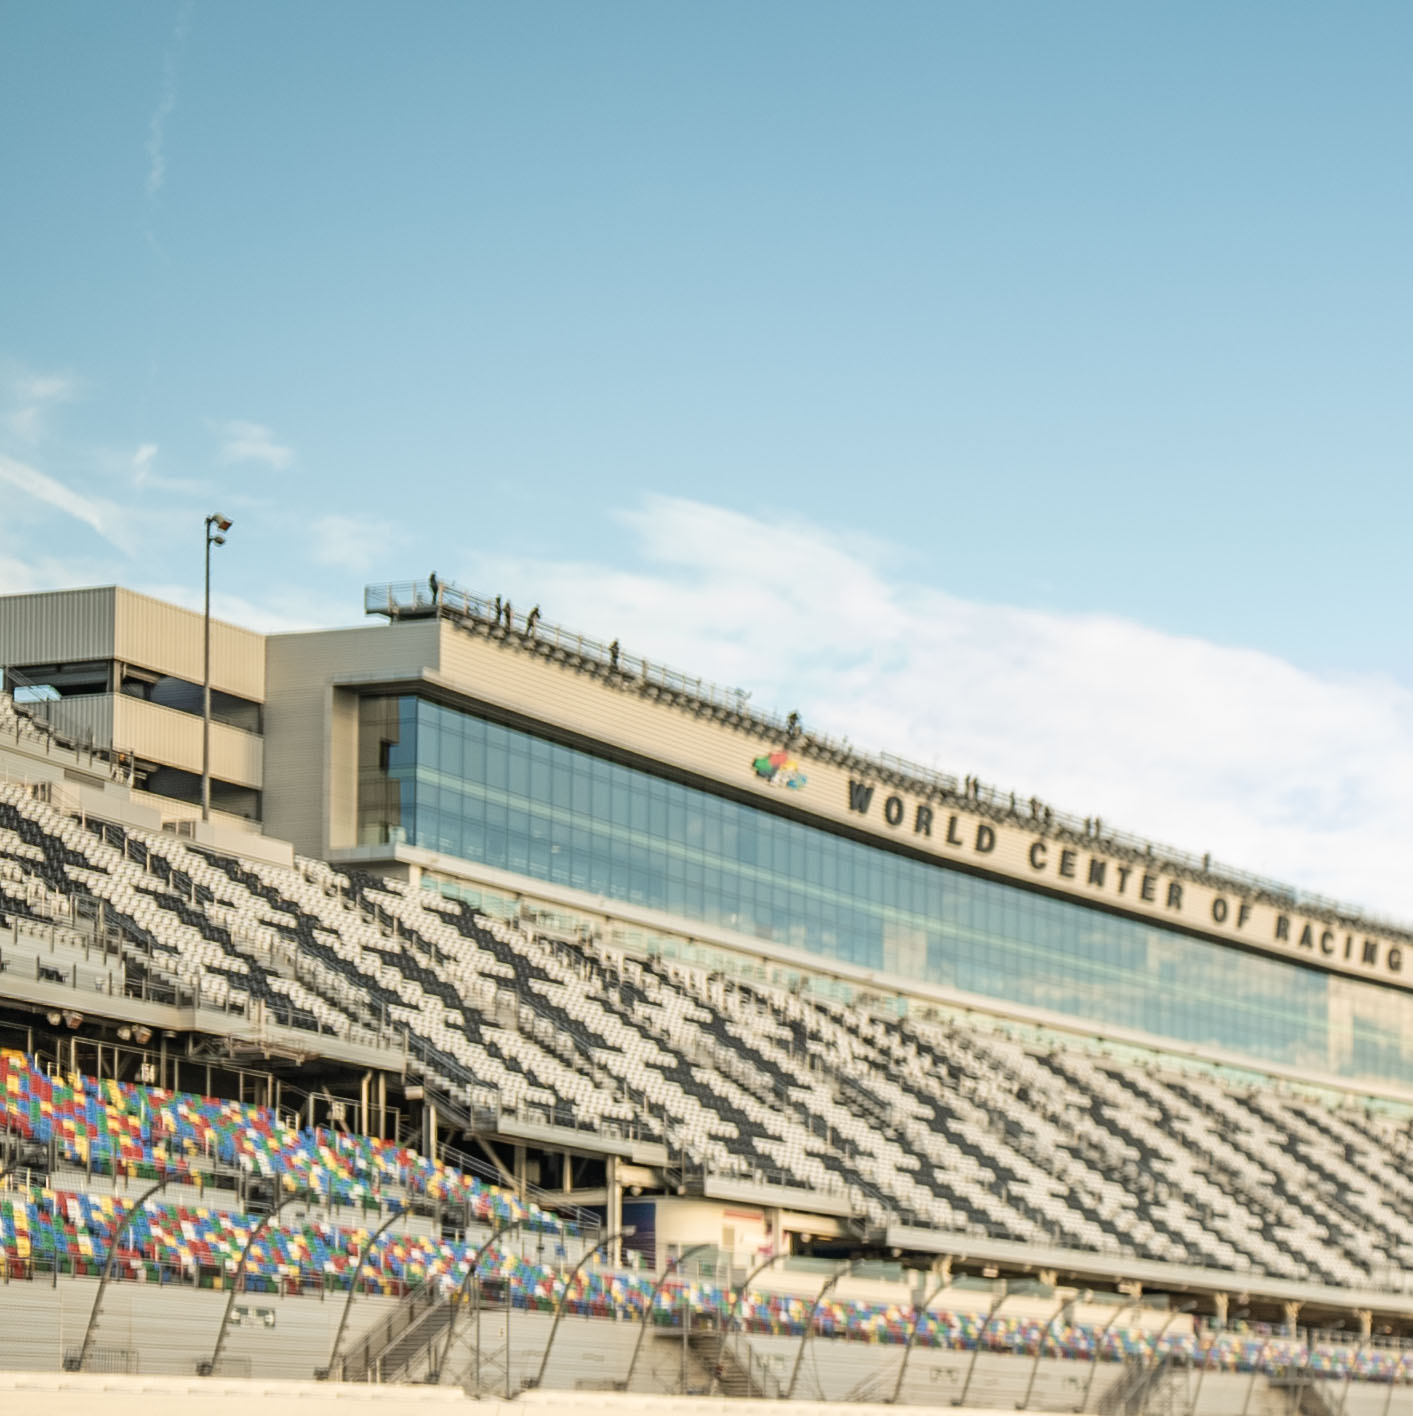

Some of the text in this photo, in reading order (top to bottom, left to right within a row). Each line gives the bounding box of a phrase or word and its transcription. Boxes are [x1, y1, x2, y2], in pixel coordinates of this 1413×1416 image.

[848, 779, 1404, 972] WORLD CENTER OF RACING
